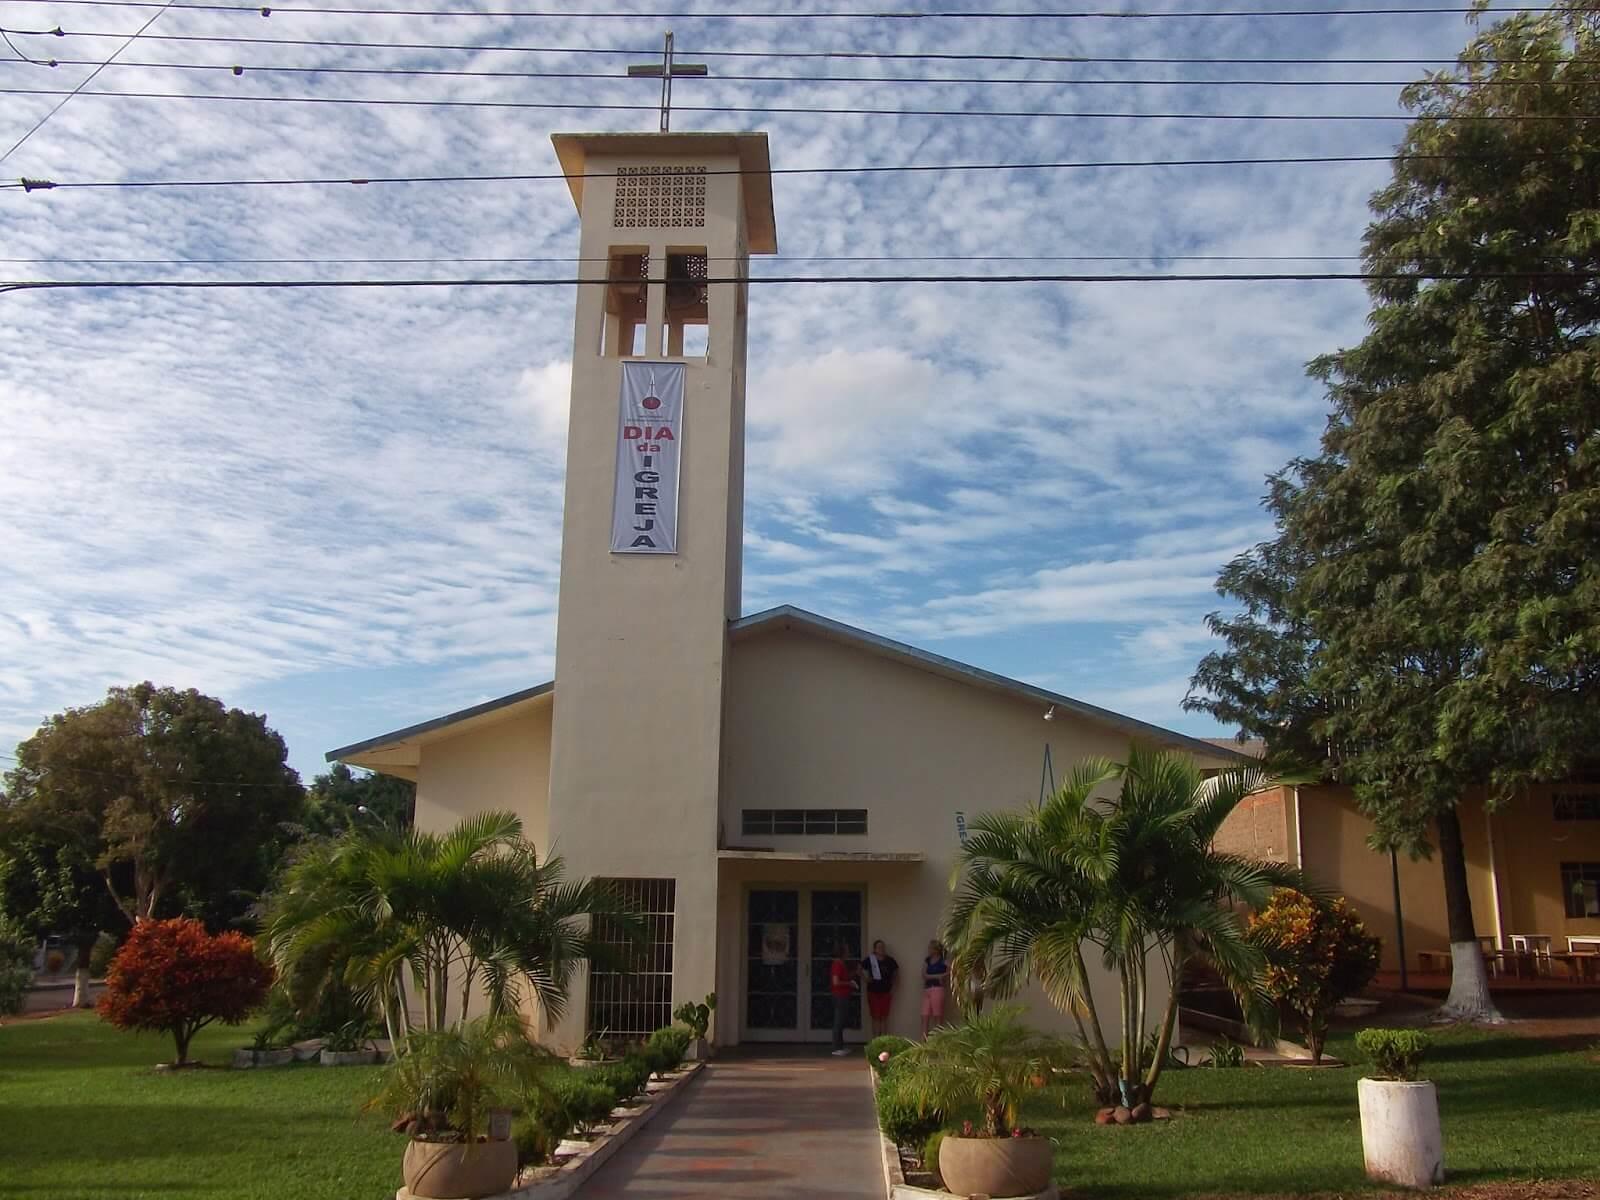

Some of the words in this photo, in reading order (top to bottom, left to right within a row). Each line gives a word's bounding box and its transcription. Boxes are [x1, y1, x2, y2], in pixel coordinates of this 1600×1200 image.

[623, 426, 675, 441] DIA
[636, 442, 661, 452] da
[630, 455, 660, 548] IGREJA
